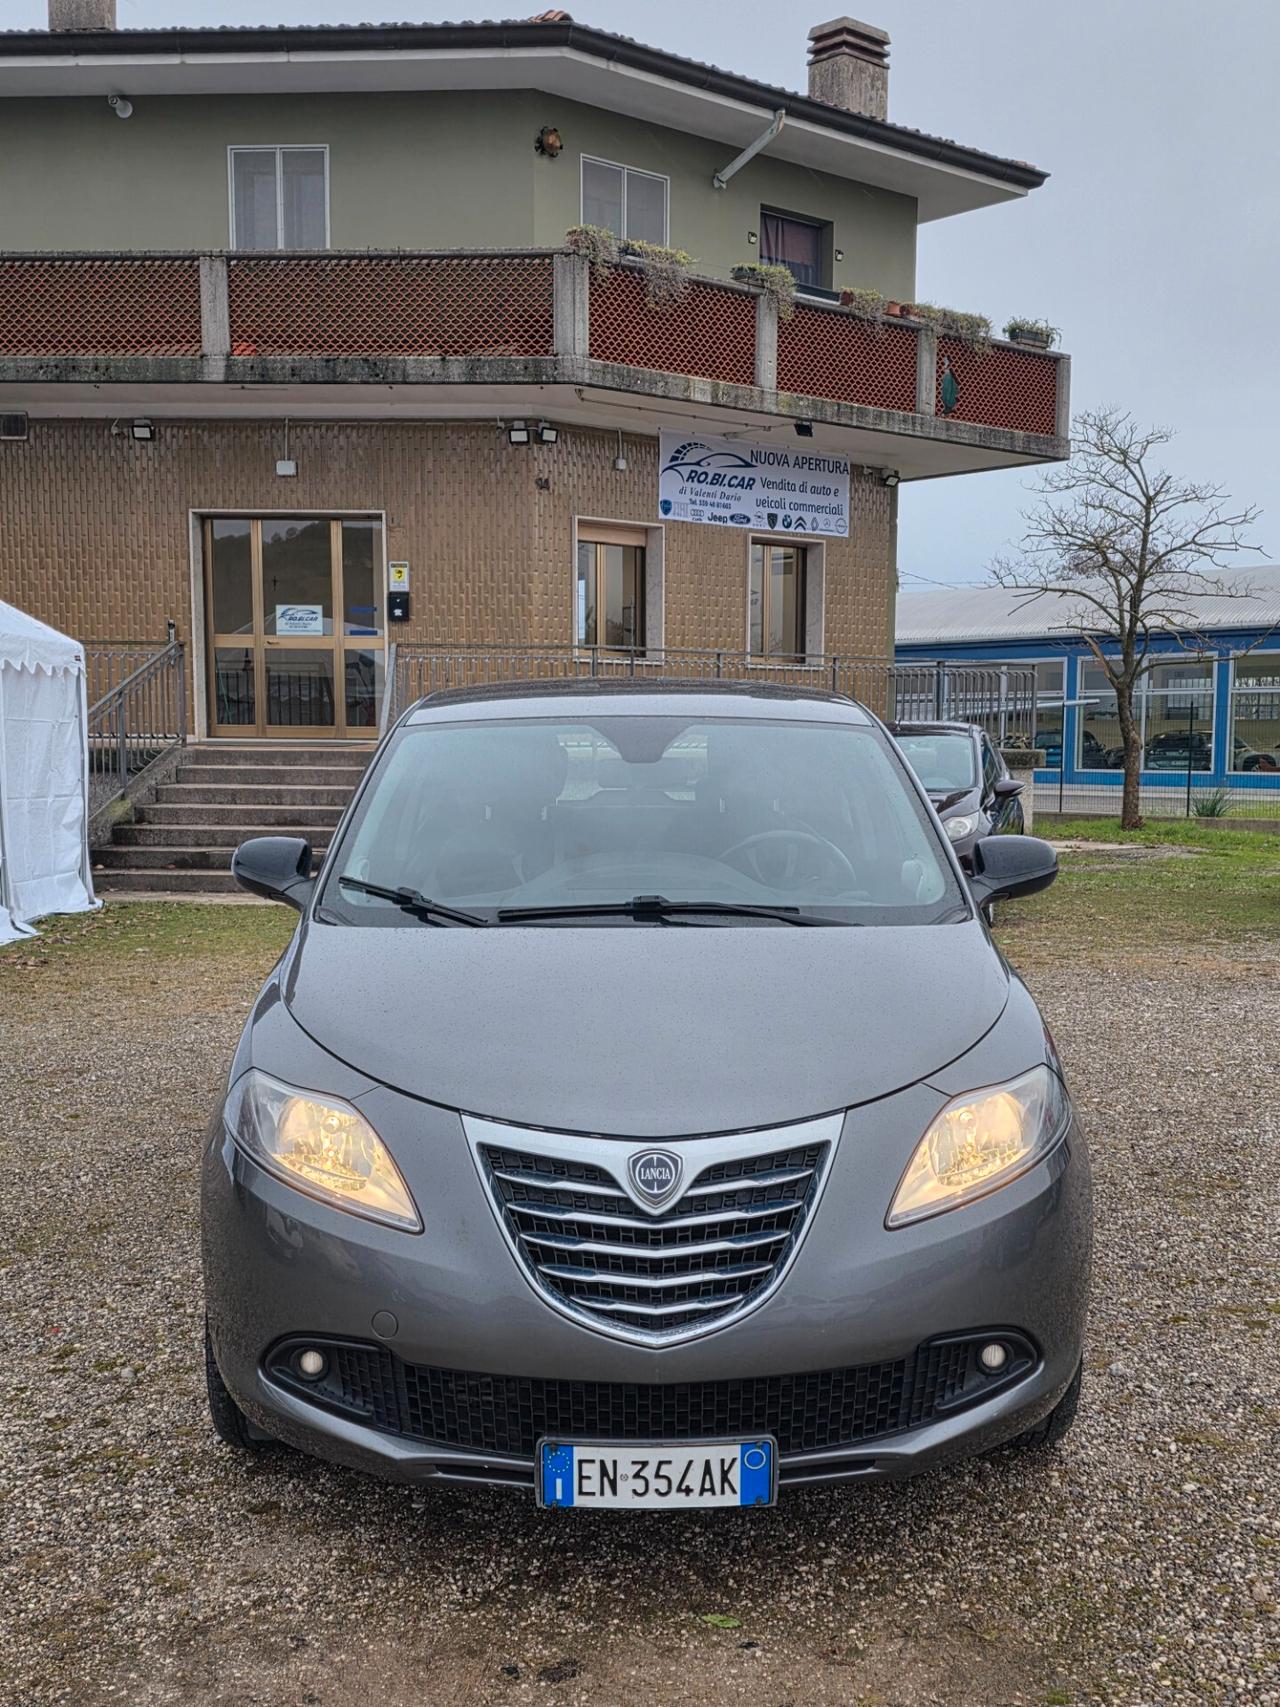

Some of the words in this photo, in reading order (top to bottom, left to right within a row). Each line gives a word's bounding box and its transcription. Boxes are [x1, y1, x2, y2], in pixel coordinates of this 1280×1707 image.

[750, 449, 790, 468] NUOVA
[792, 455, 850, 475] APERTURA
[685, 469, 756, 491] RO.BI.CAR
[760, 476, 796, 493] Vendita
[798, 480, 808, 494] di
[809, 484, 831, 496] auto
[833, 488, 840, 497] e
[678, 485, 687, 495] di
[689, 487, 717, 499] Valenti
[719, 491, 742, 502] Dario
[755, 496, 786, 511] veicoli
[788, 500, 844, 517] commerciali
[707, 511, 728, 525] Jeep
[640, 1167, 671, 1180] LANCIA
